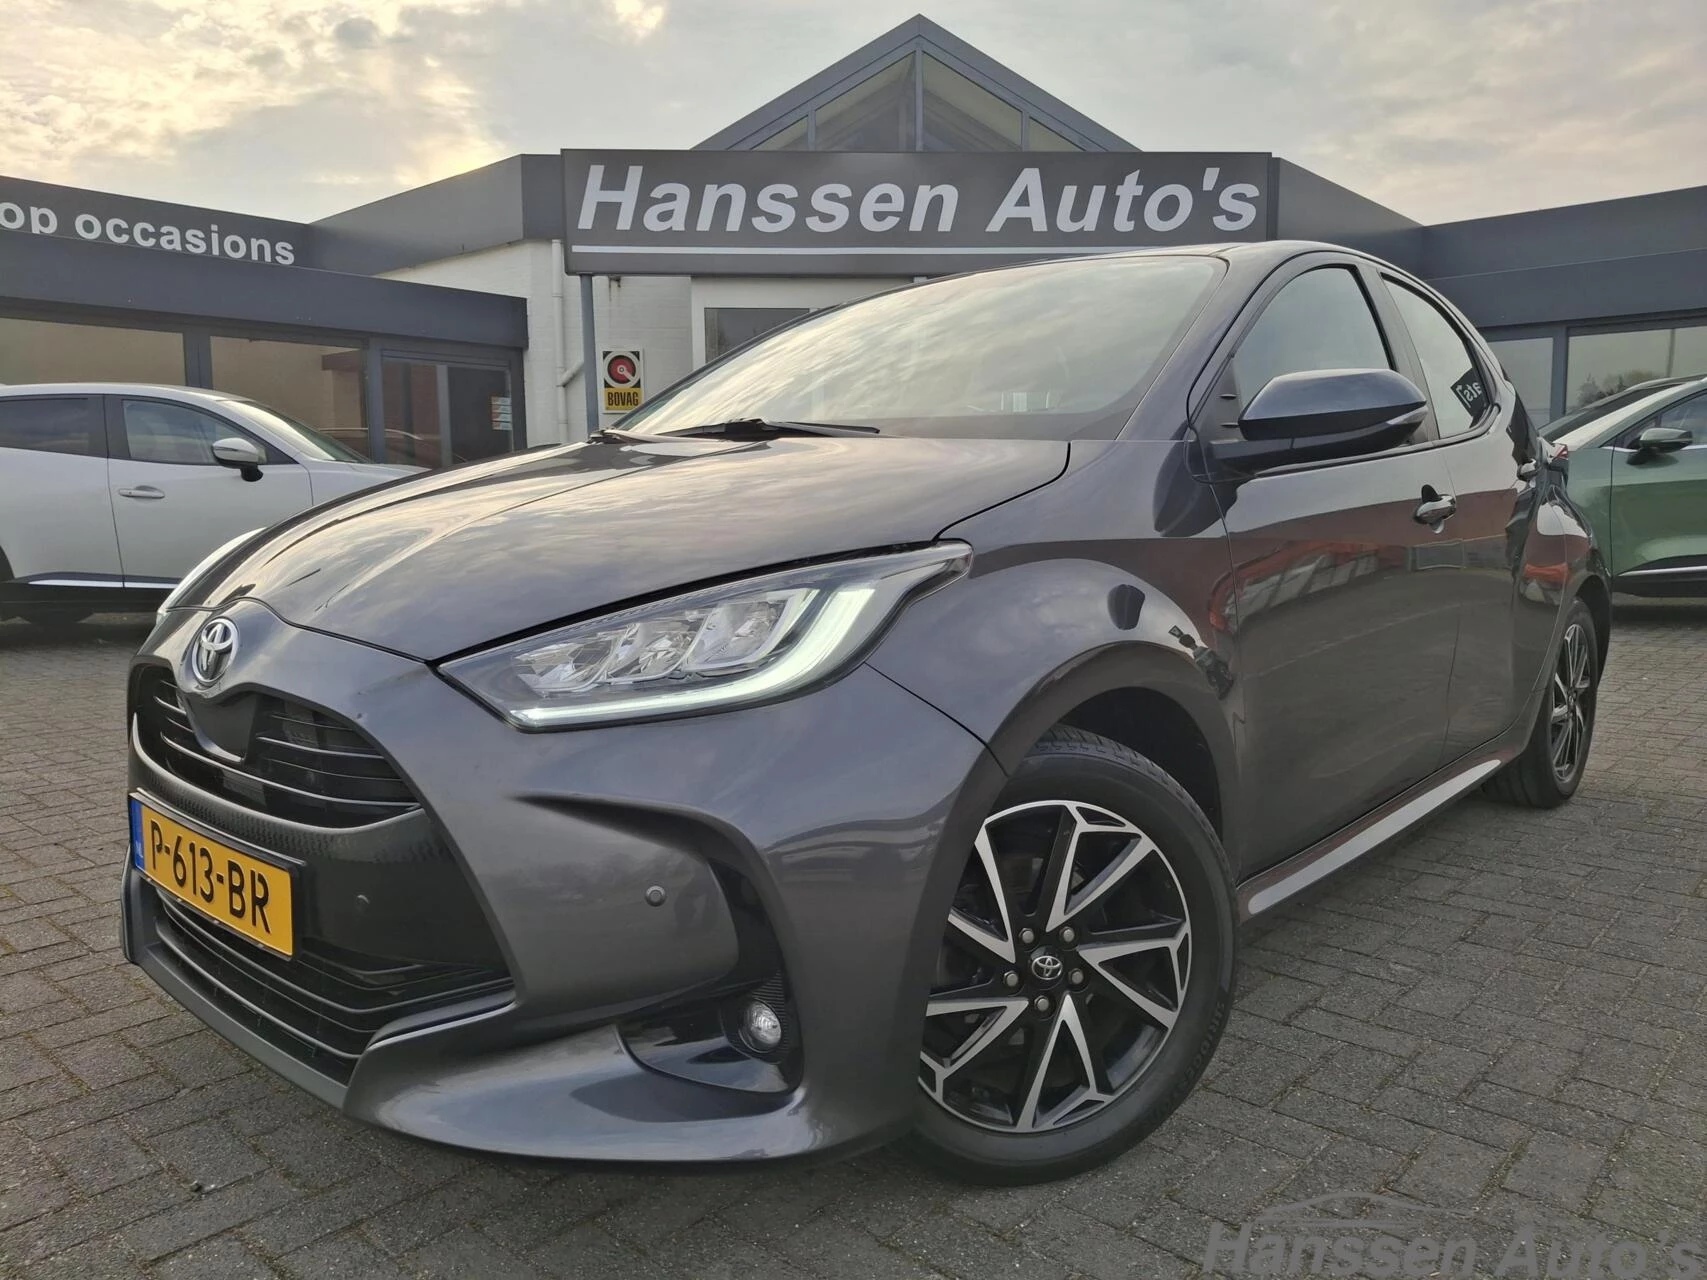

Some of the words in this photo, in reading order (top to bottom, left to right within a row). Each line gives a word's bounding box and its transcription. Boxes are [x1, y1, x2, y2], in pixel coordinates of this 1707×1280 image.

[577, 164, 959, 233] Hanssen
[985, 167, 1260, 232] Auto's
[75, 213, 295, 265] occasions
[607, 391, 639, 406] BOVAG
[150, 820, 271, 935] P-613-BR
